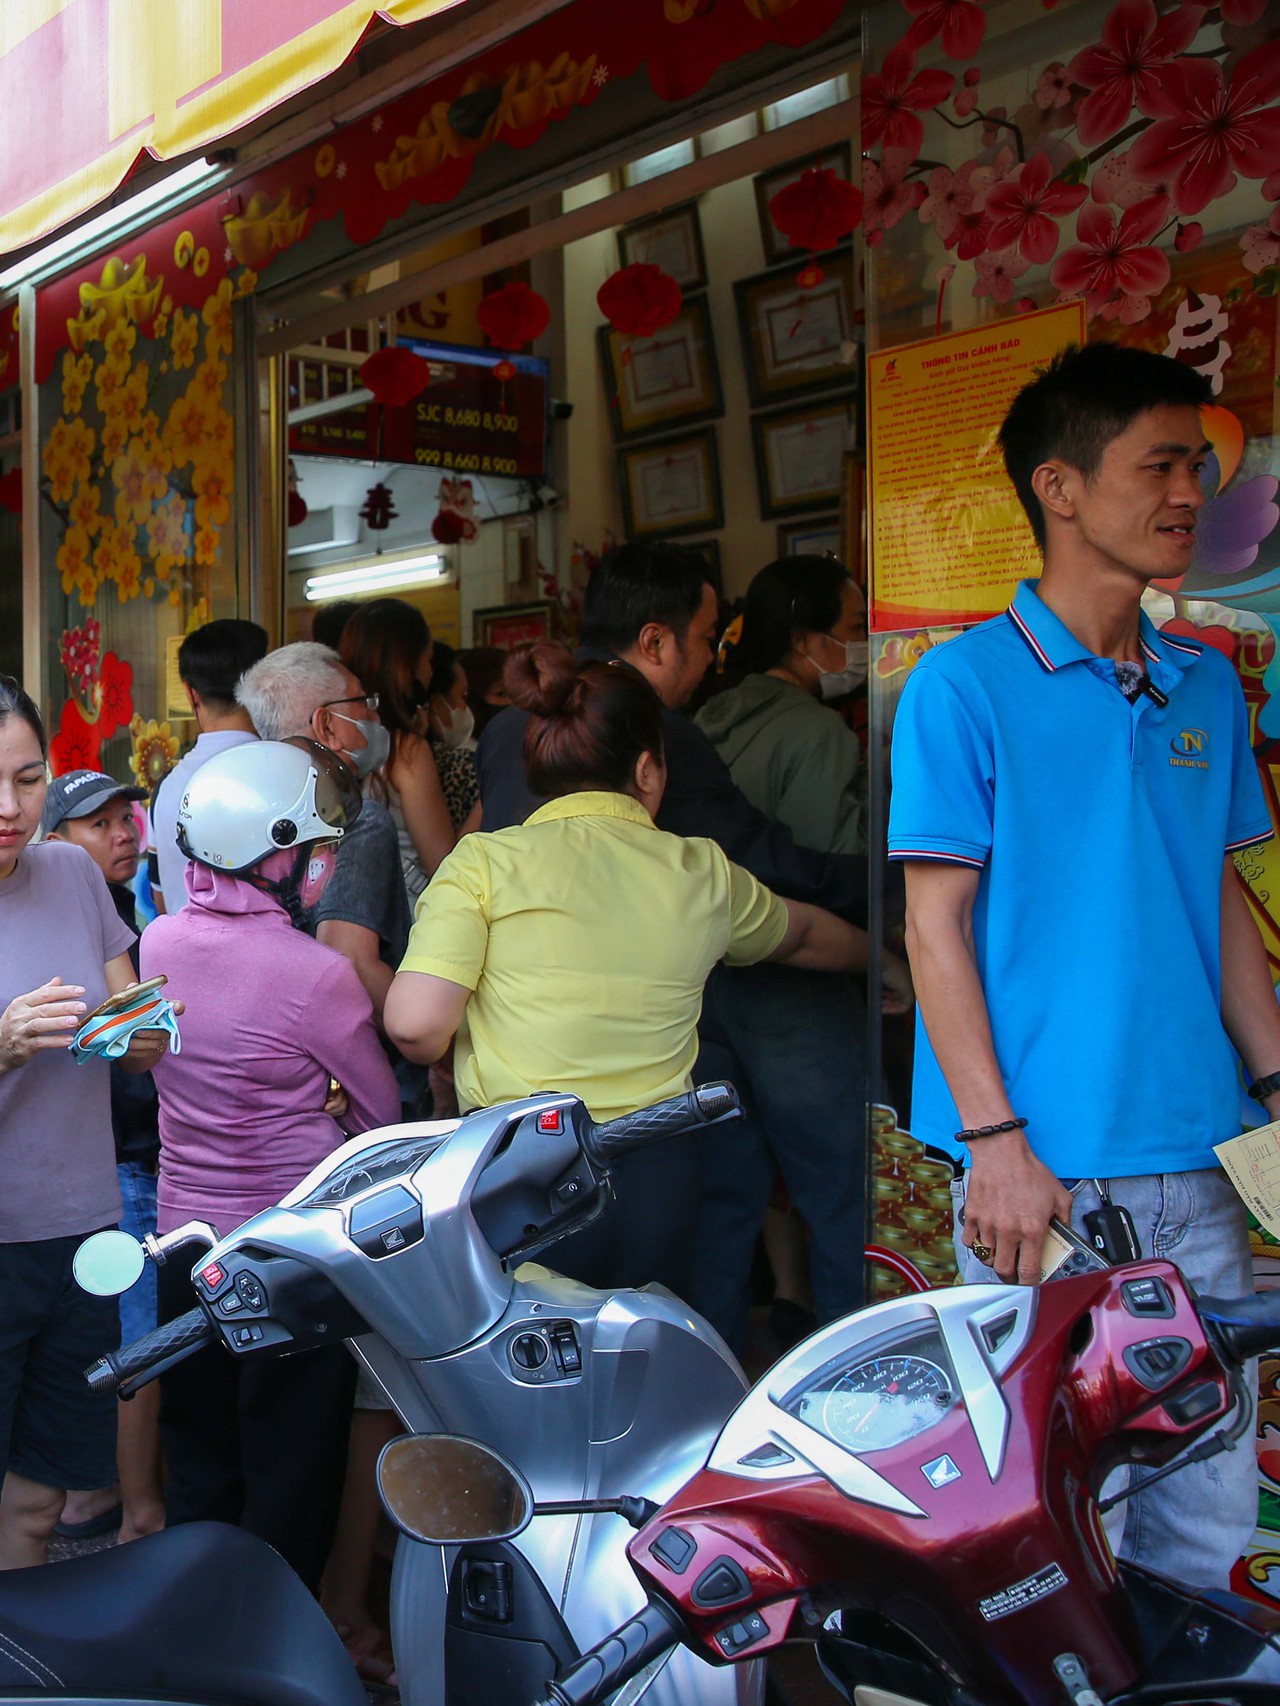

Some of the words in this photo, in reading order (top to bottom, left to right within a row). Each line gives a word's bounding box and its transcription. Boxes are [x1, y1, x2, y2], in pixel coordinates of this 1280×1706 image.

[416, 402, 441, 423] SJC
[444, 406, 480, 428] 8,680
[483, 412, 518, 432] 8,900
[415, 447, 441, 464] 999
